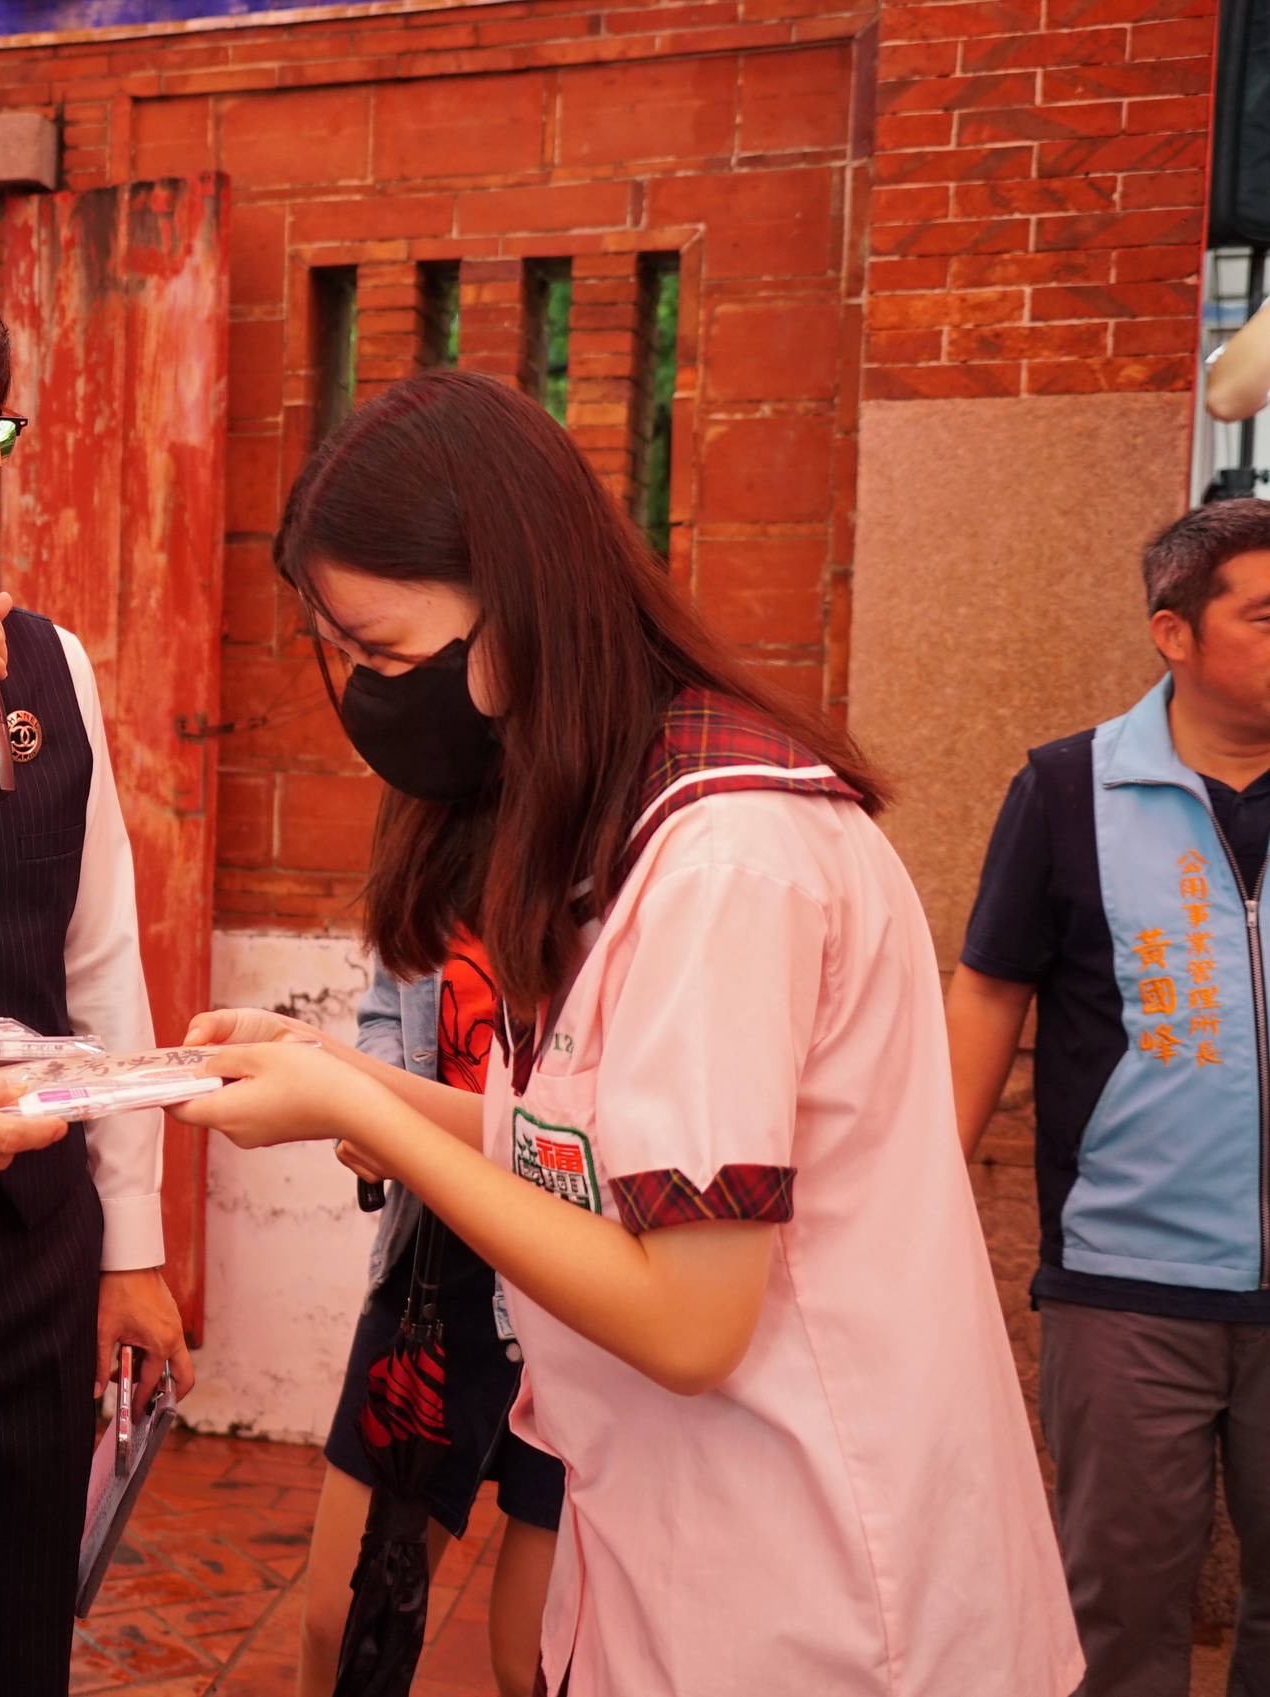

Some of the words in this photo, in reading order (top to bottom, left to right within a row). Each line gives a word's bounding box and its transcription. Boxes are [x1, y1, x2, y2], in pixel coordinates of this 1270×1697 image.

[6, 713, 39, 729] HANEL
[1176, 849, 1225, 1067] 公用事業管理所長
